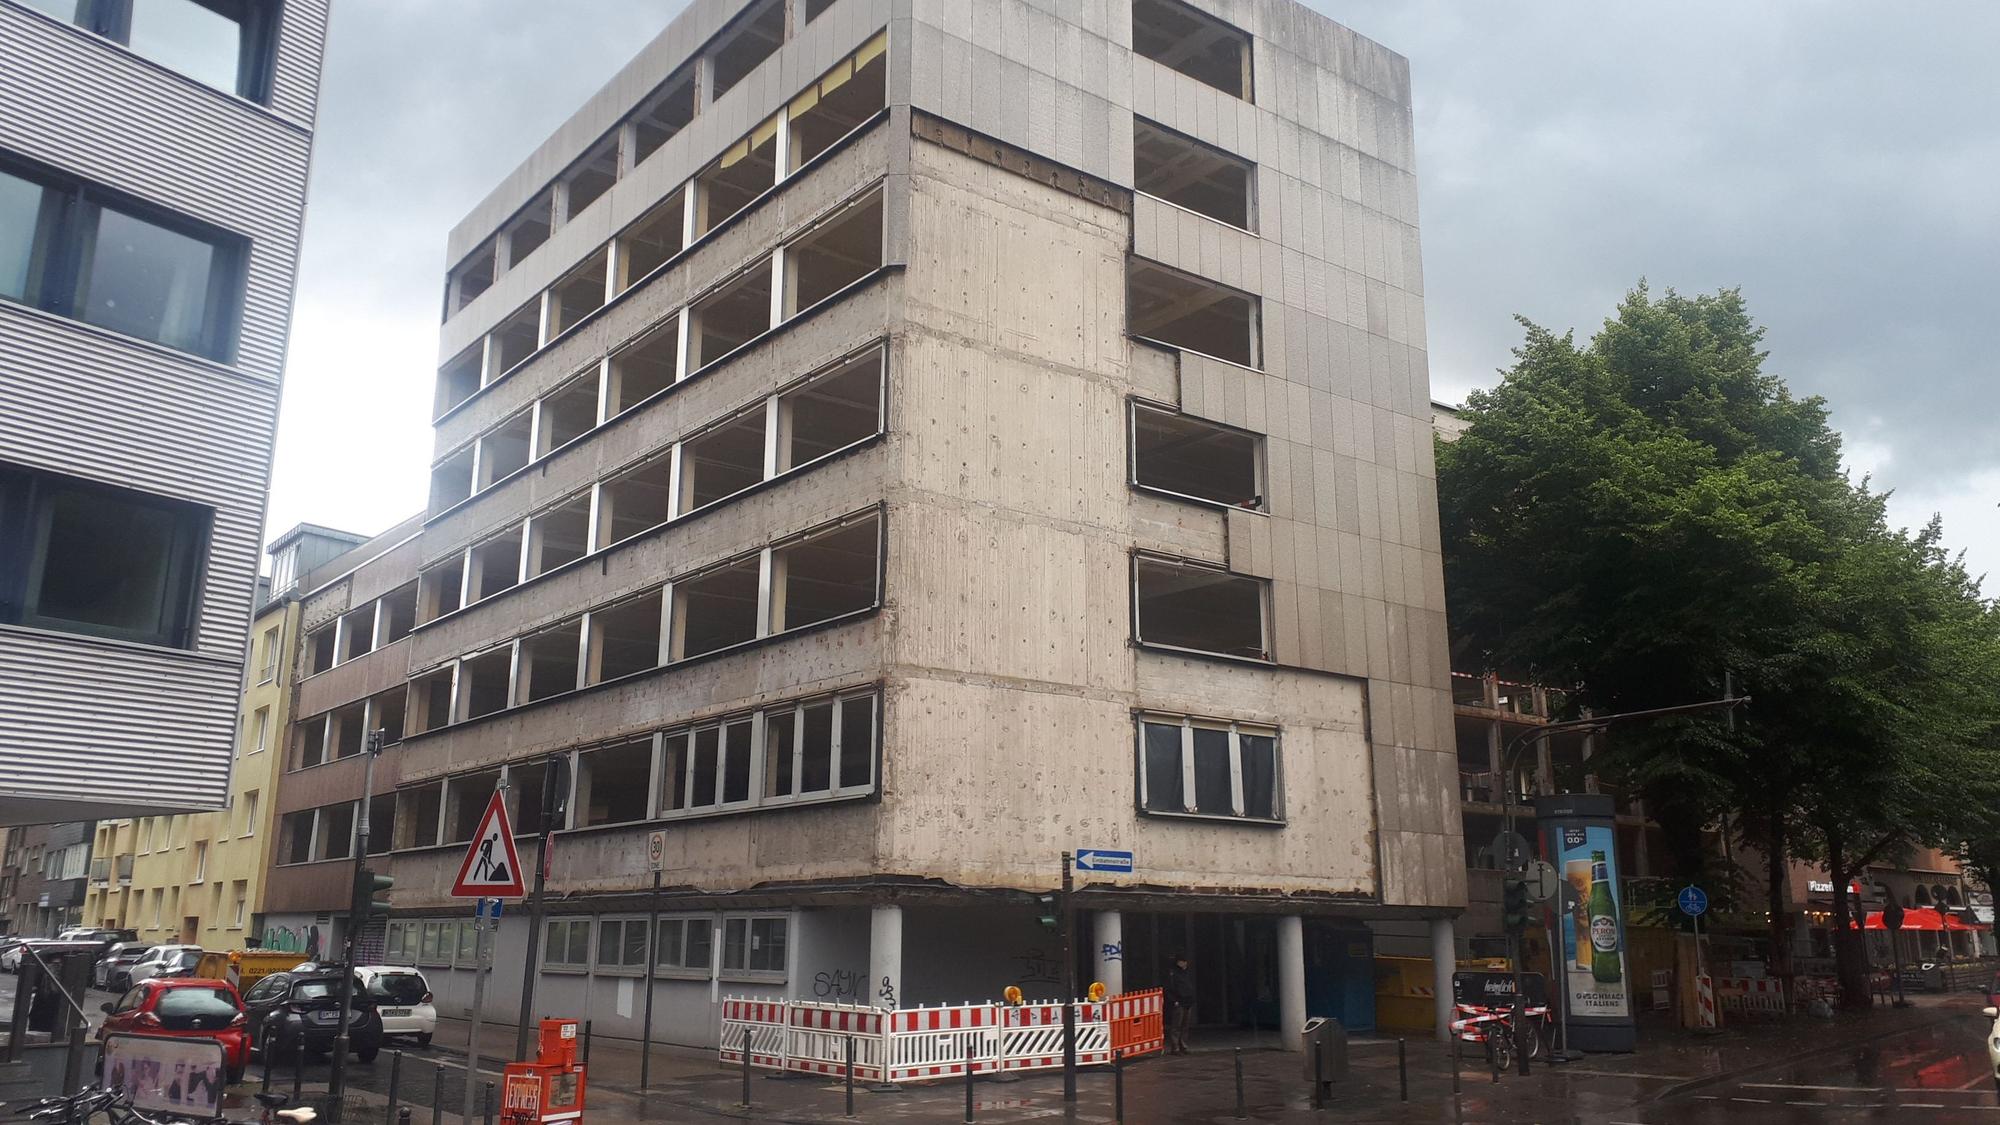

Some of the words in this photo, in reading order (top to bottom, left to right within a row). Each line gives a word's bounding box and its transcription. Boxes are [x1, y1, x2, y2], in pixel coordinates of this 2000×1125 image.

[652, 841, 660, 853] 30
[1808, 880, 1837, 892] Pizzeri
[508, 1082, 538, 1110] EXPRESS
